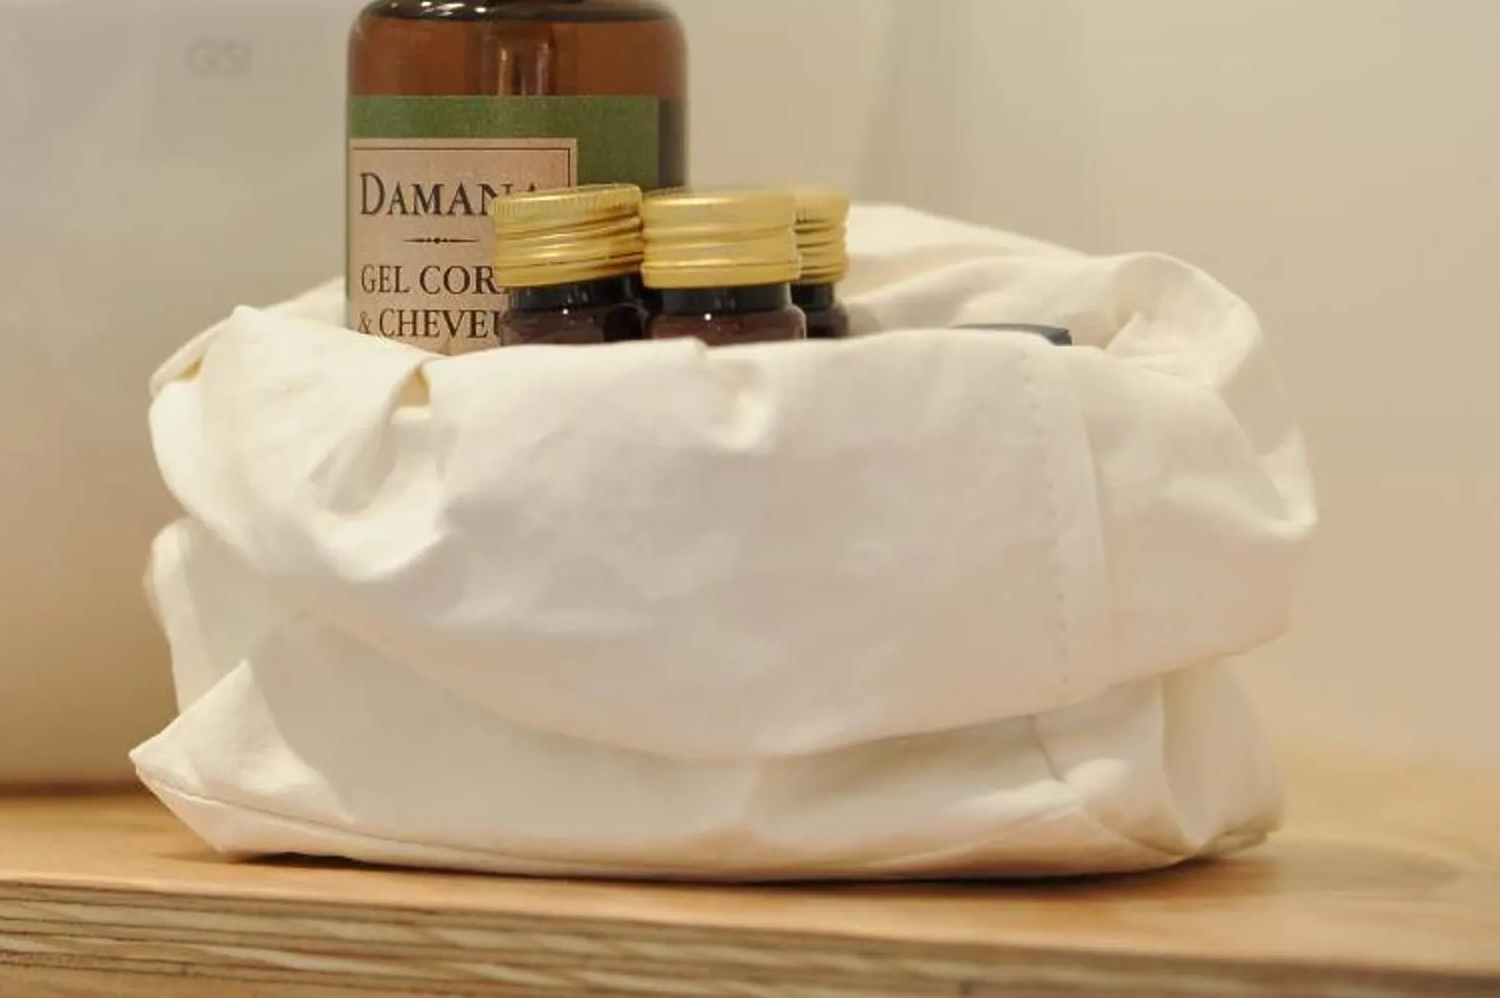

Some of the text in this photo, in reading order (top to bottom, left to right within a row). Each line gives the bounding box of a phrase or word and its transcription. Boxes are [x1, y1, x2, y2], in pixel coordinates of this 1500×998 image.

[360, 172, 537, 217] DAMAN
[361, 264, 510, 295] GEL COR
[358, 310, 373, 334] &
